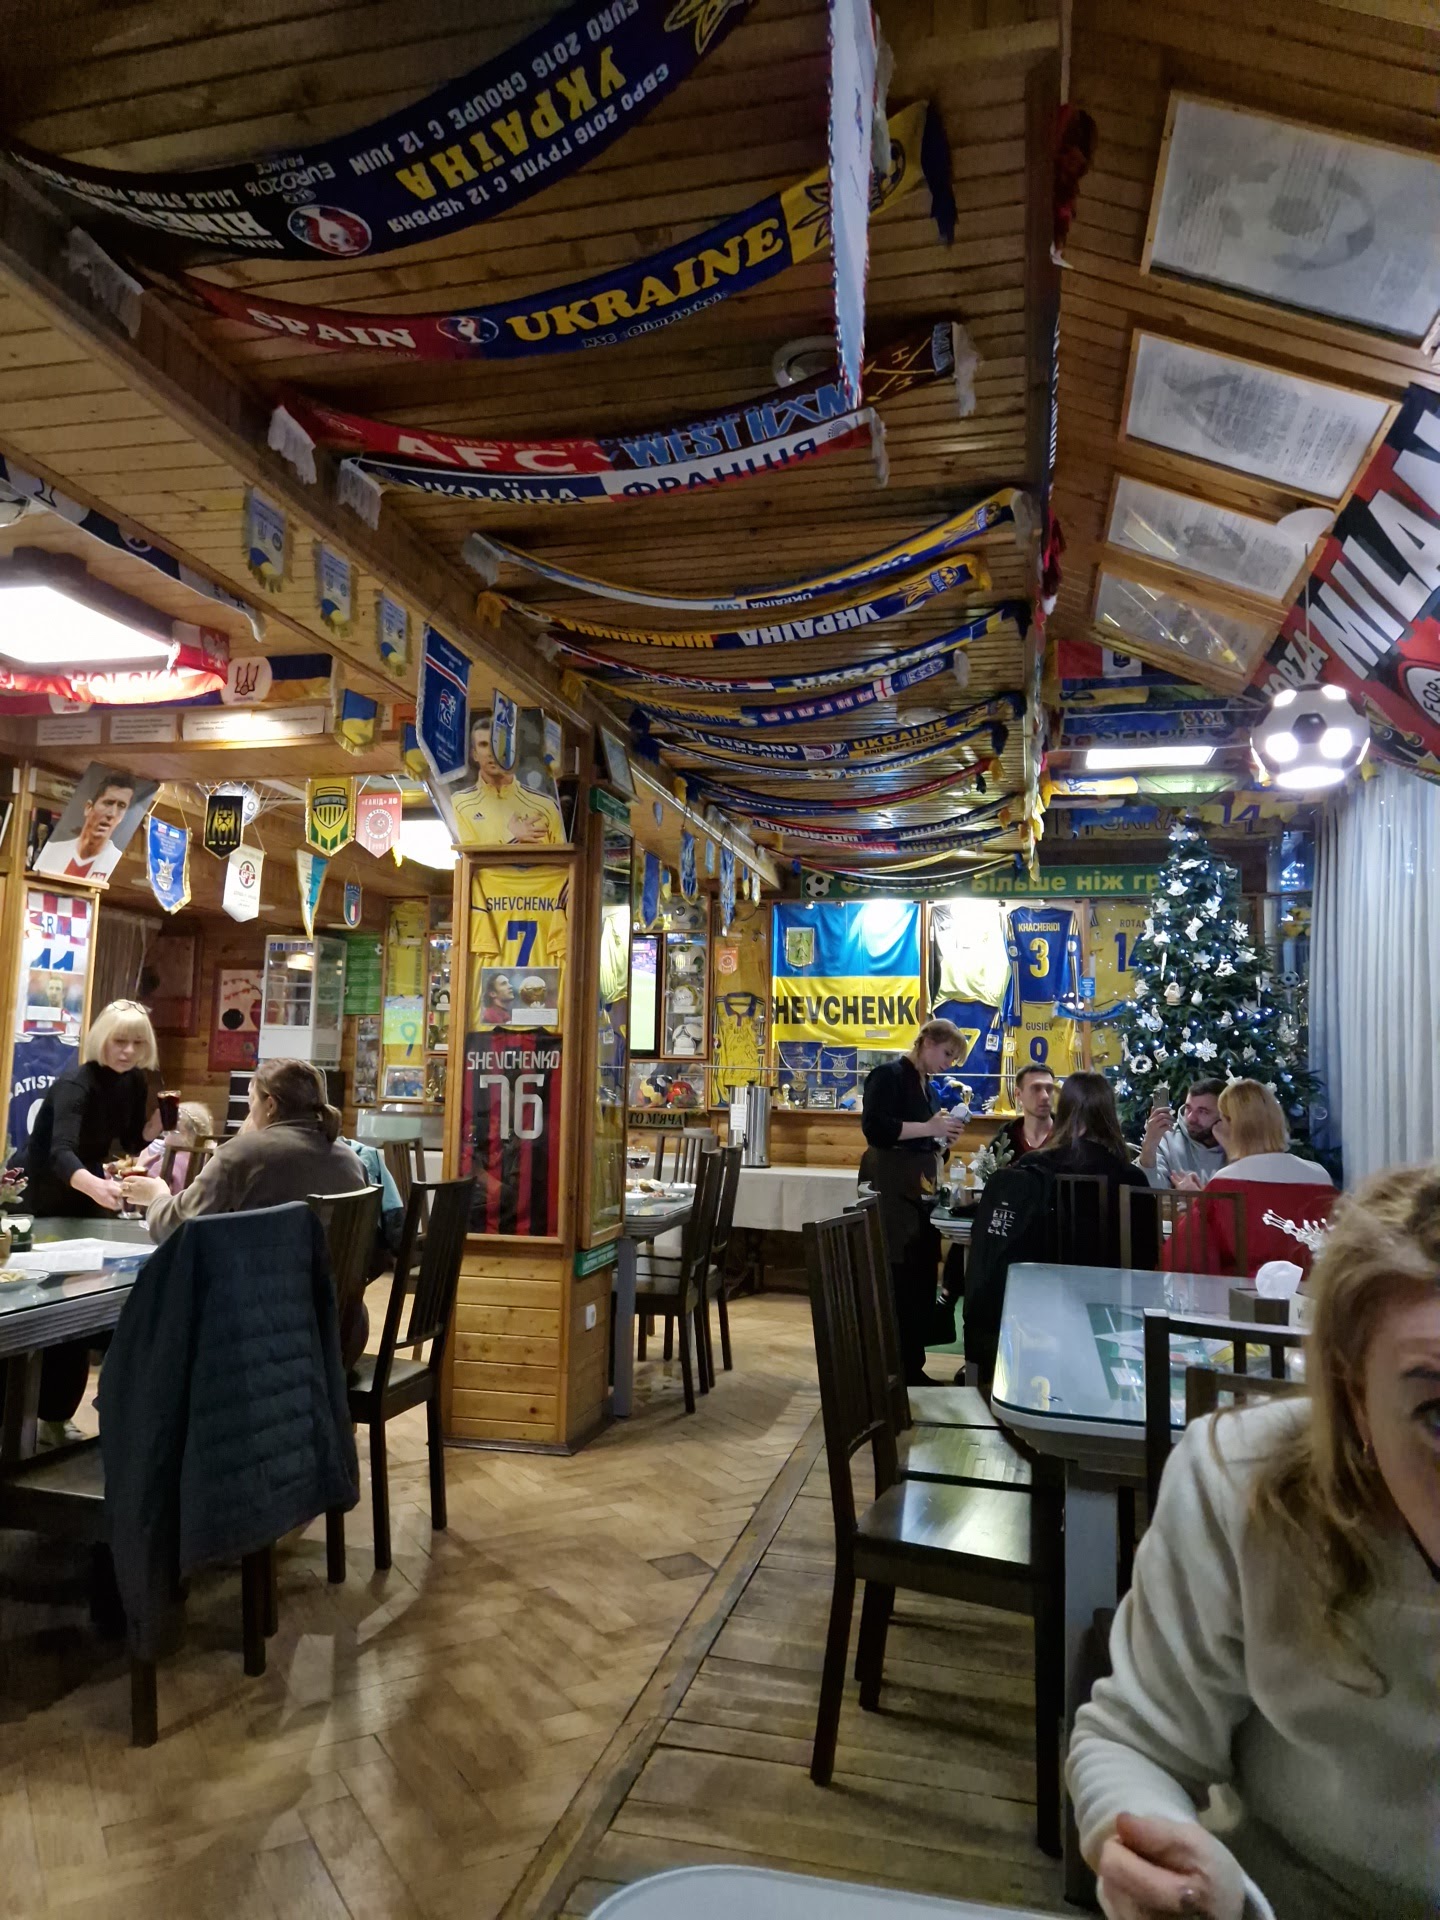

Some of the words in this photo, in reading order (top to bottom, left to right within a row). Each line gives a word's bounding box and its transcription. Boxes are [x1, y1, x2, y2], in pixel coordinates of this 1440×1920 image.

[531, 31, 582, 79] 2016
[447, 71, 528, 131] GROUPE
[621, 63, 670, 112] ЄВРО
[395, 45, 627, 201] УКРАЇНА
[397, 130, 425, 154] 12
[575, 104, 619, 145] 2016
[348, 142, 395, 177] JUIN
[510, 138, 573, 185] ГРУПА
[387, 198, 466, 234] ЧЕРВНЯ
[466, 189, 491, 207] 12
[507, 219, 785, 343] UKRAINE
[247, 308, 417, 350] SPAIN
[398, 435, 578, 473] AFC
[619, 414, 743, 467] WEST
[707, 735, 798, 754] ENGLAND
[852, 720, 947, 751] UKRAINE
[1076, 873, 1123, 892] ніж
[1132, 872, 1163, 894] гр
[486, 896, 557, 912] SHEVCHENK
[506, 920, 538, 968] 7
[1018, 922, 1061, 932] KHACHERIDI
[1029, 937, 1050, 978] 3
[773, 995, 921, 1026] HEVCHENK
[1025, 1022, 1054, 1031] GUSIEV
[466, 1050, 561, 1071] SHEVCHENKO
[479, 1074, 545, 1140] 76
